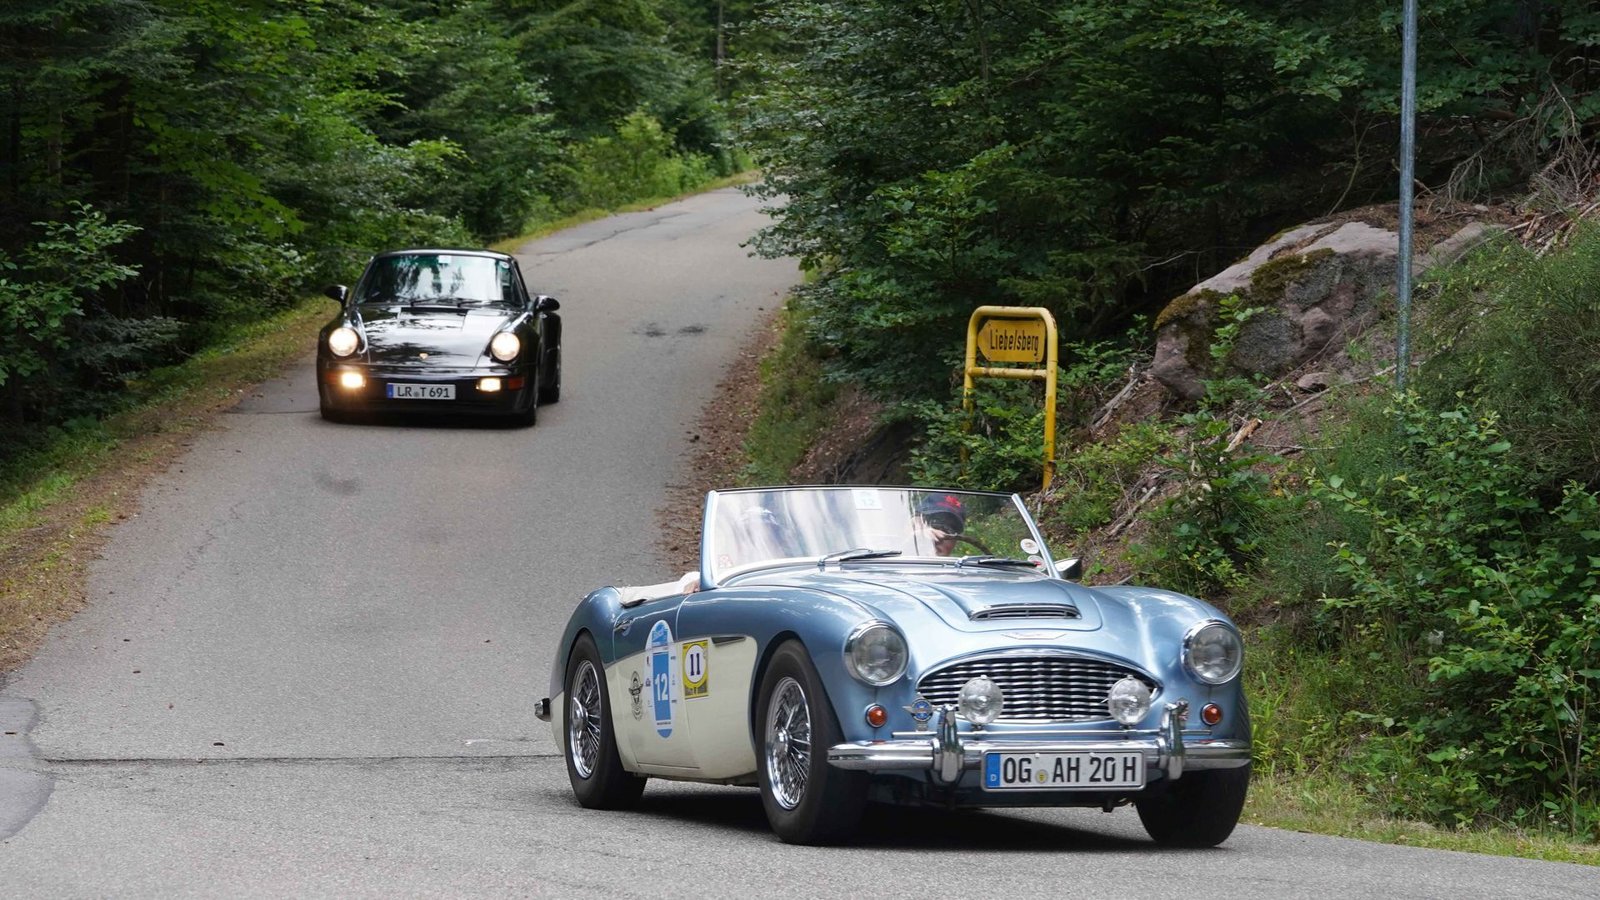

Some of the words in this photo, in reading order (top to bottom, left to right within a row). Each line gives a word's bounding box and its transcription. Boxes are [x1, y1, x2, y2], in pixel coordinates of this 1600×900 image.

[990, 329, 1039, 356] Liebelsberg
[397, 386, 412, 397] LR
[420, 387, 427, 397] T
[429, 387, 450, 398] 691
[690, 653, 700, 676] 11
[655, 673, 668, 701] 12
[1003, 757, 1032, 784] OG
[1052, 757, 1080, 783] AH
[1089, 757, 1116, 782] 20
[1123, 756, 1136, 782] H
